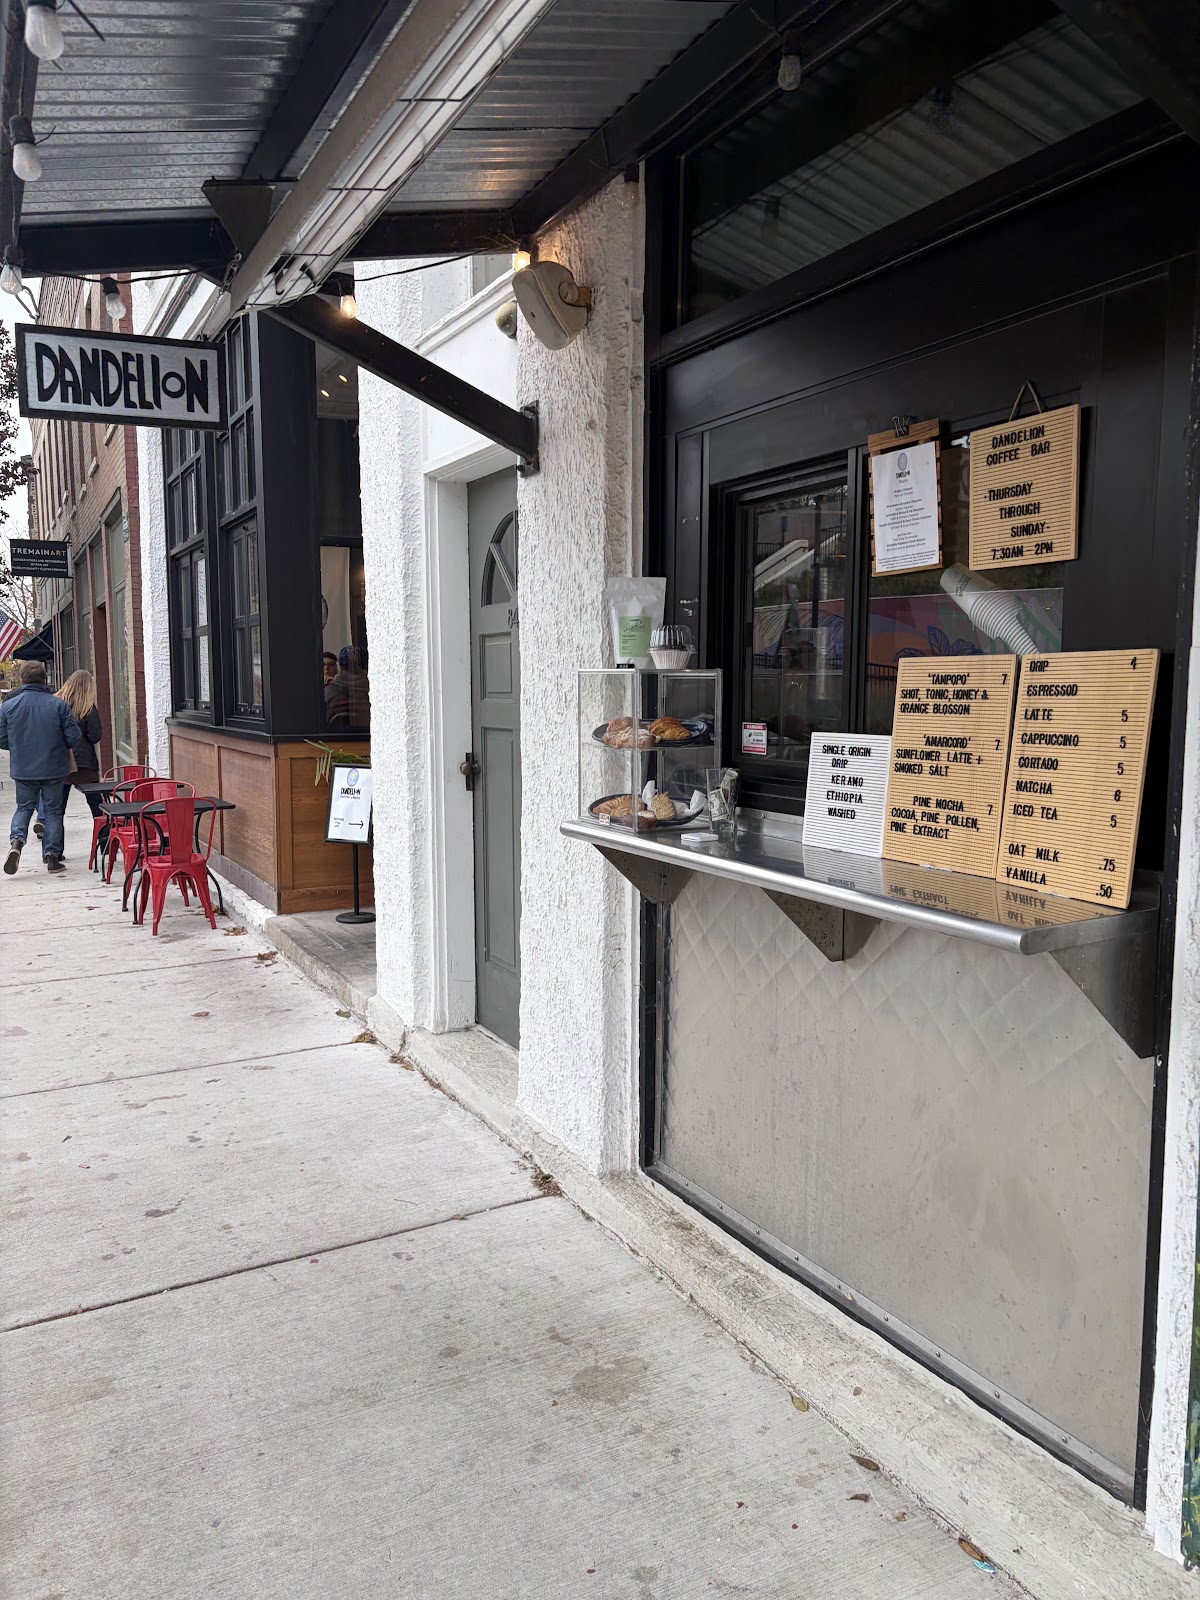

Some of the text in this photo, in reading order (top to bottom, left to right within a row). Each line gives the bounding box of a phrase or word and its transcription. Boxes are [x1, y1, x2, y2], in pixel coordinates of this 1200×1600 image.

[35, 342, 208, 414] DANDELION
[992, 425, 1045, 449] DANDELION
[987, 441, 1050, 466] COFFEE BAR
[999, 502, 1040, 519] THROUGH
[992, 545, 1023, 560] 7:30AM
[1035, 541, 1053, 556] 2PM
[1030, 657, 1137, 672] DRIP 4
[1002, 674, 1008, 685] 7
[901, 689, 989, 702] SHOT, TONIC, HONEY &
[900, 703, 970, 715] ORANGE BLOSSOM
[1024, 709, 1129, 723] LATTE 5
[995, 740, 1000, 751] 7
[1021, 733, 1126, 749] CAPPUCCINO 5
[822, 745, 871, 757] SINGLE ORIGIN
[896, 749, 983, 765] SUNFLOWER LATTE +
[832, 758, 848, 768] DRIP
[895, 762, 949, 777] SMOKED SALT
[1018, 756, 1124, 775] CORTADO 5
[827, 791, 863, 804] ETHIOPIA
[1016, 780, 1121, 802] MATCHA 6
[828, 807, 856, 819] WASHED
[913, 796, 993, 815] PINE MOCHA 7
[891, 808, 979, 832] COCOA, PINE POLLEN,
[1013, 804, 1117, 828] ICED TEA 5
[891, 821, 950, 840] PINE EXTRACT
[1008, 843, 1115, 872] OAT MILK .75
[1006, 866, 1112, 899] VANILLA .50
